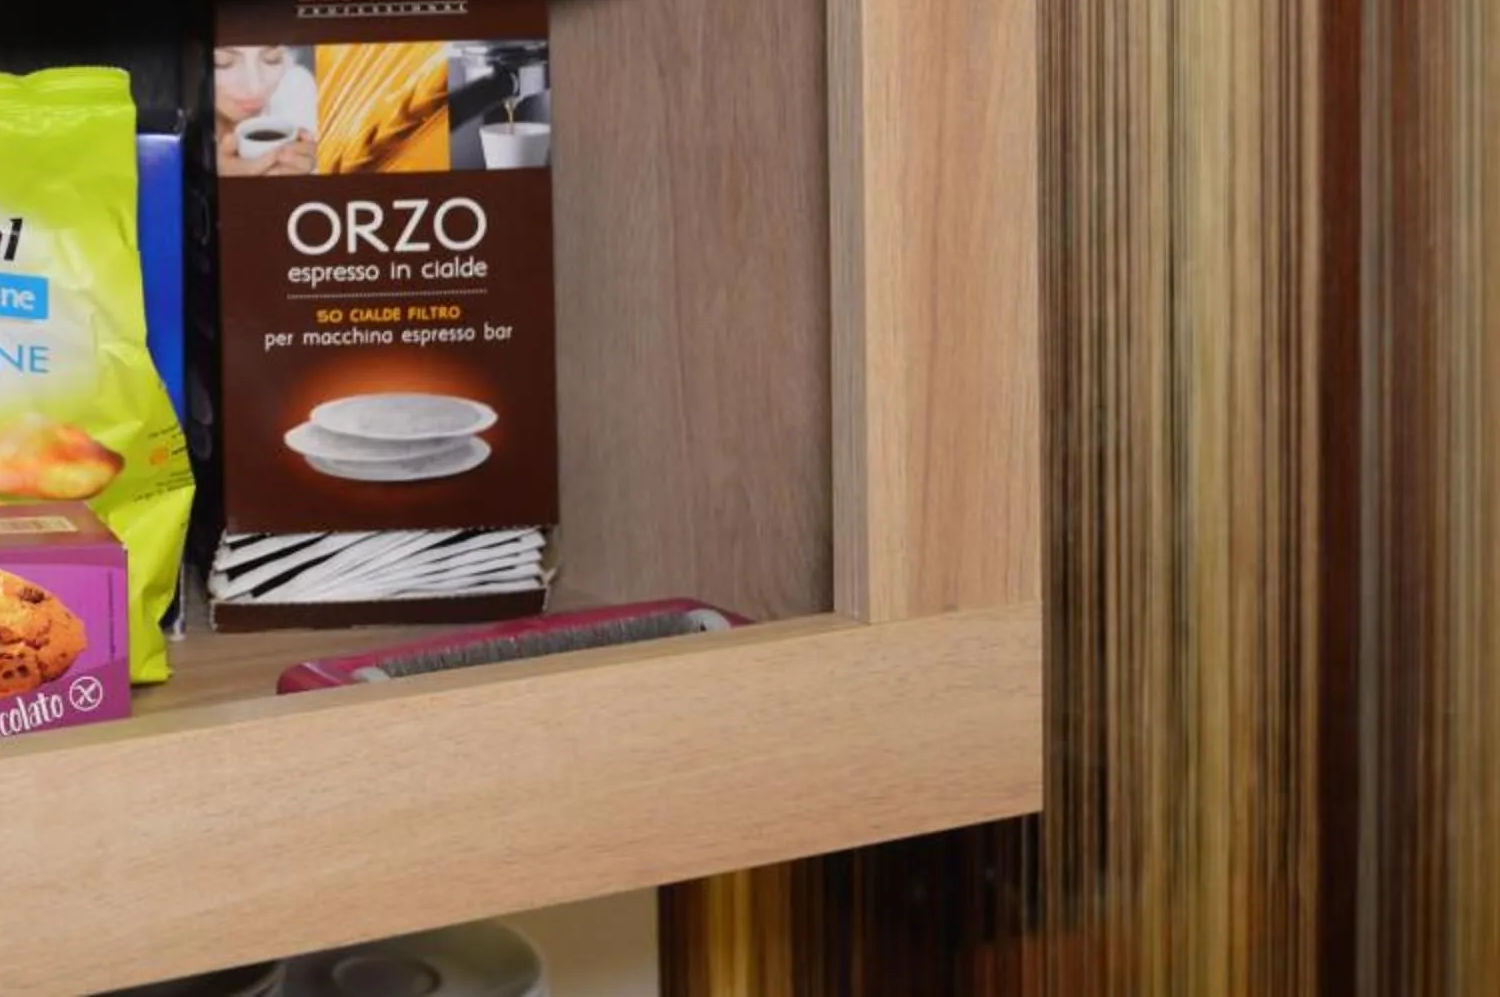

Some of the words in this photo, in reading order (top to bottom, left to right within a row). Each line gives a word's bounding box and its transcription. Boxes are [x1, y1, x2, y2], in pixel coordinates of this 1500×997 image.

[287, 198, 488, 255] ORZO
[288, 264, 380, 288] espresso
[390, 262, 411, 280] in
[421, 256, 488, 279] cialde
[316, 309, 343, 324] 50
[350, 307, 401, 322] CIALDE
[408, 306, 461, 320] FILTRO
[264, 331, 293, 351] per
[303, 328, 393, 346] macchina
[401, 326, 475, 347] espresso
[483, 322, 513, 341] bar
